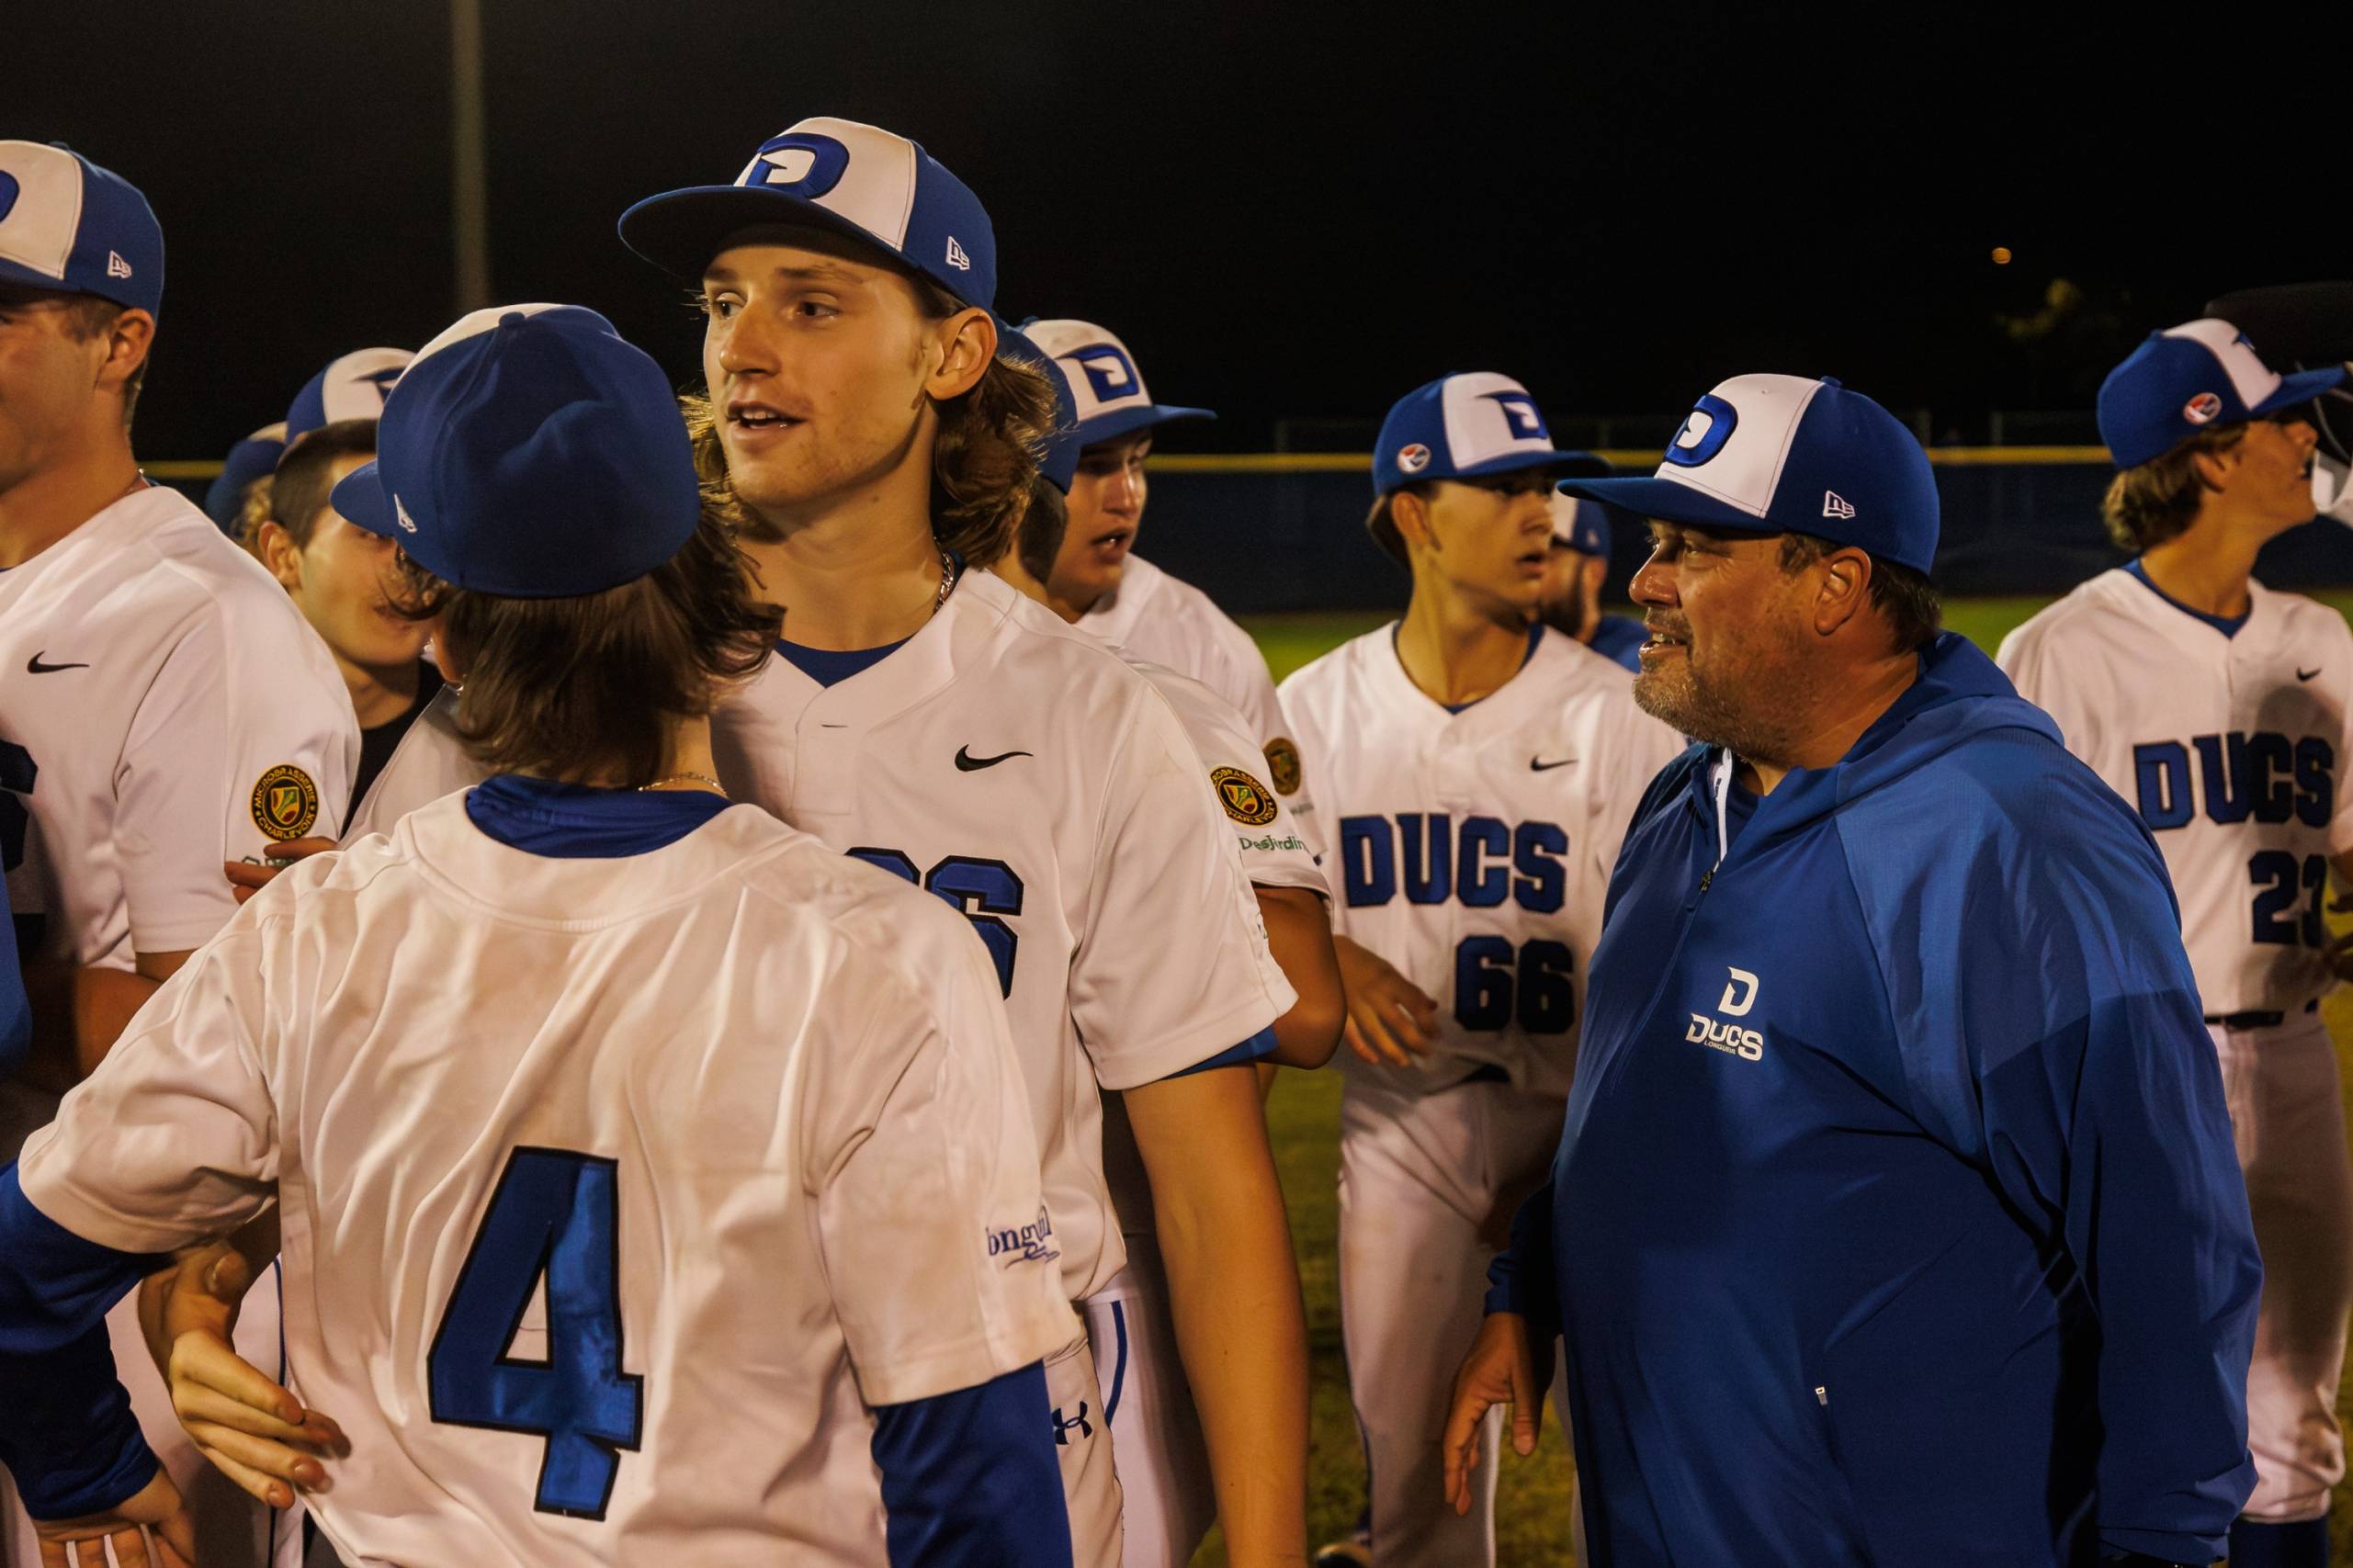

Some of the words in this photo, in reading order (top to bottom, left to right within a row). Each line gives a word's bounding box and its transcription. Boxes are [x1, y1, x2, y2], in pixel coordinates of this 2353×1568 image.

[2132, 731, 2335, 832] DUCS
[1339, 813, 1569, 915] DUCS
[1454, 933, 1576, 1035] 66
[1717, 965, 1759, 1017] D
[1684, 1012, 1764, 1062] DUCS
[426, 1145, 645, 1522] 4
